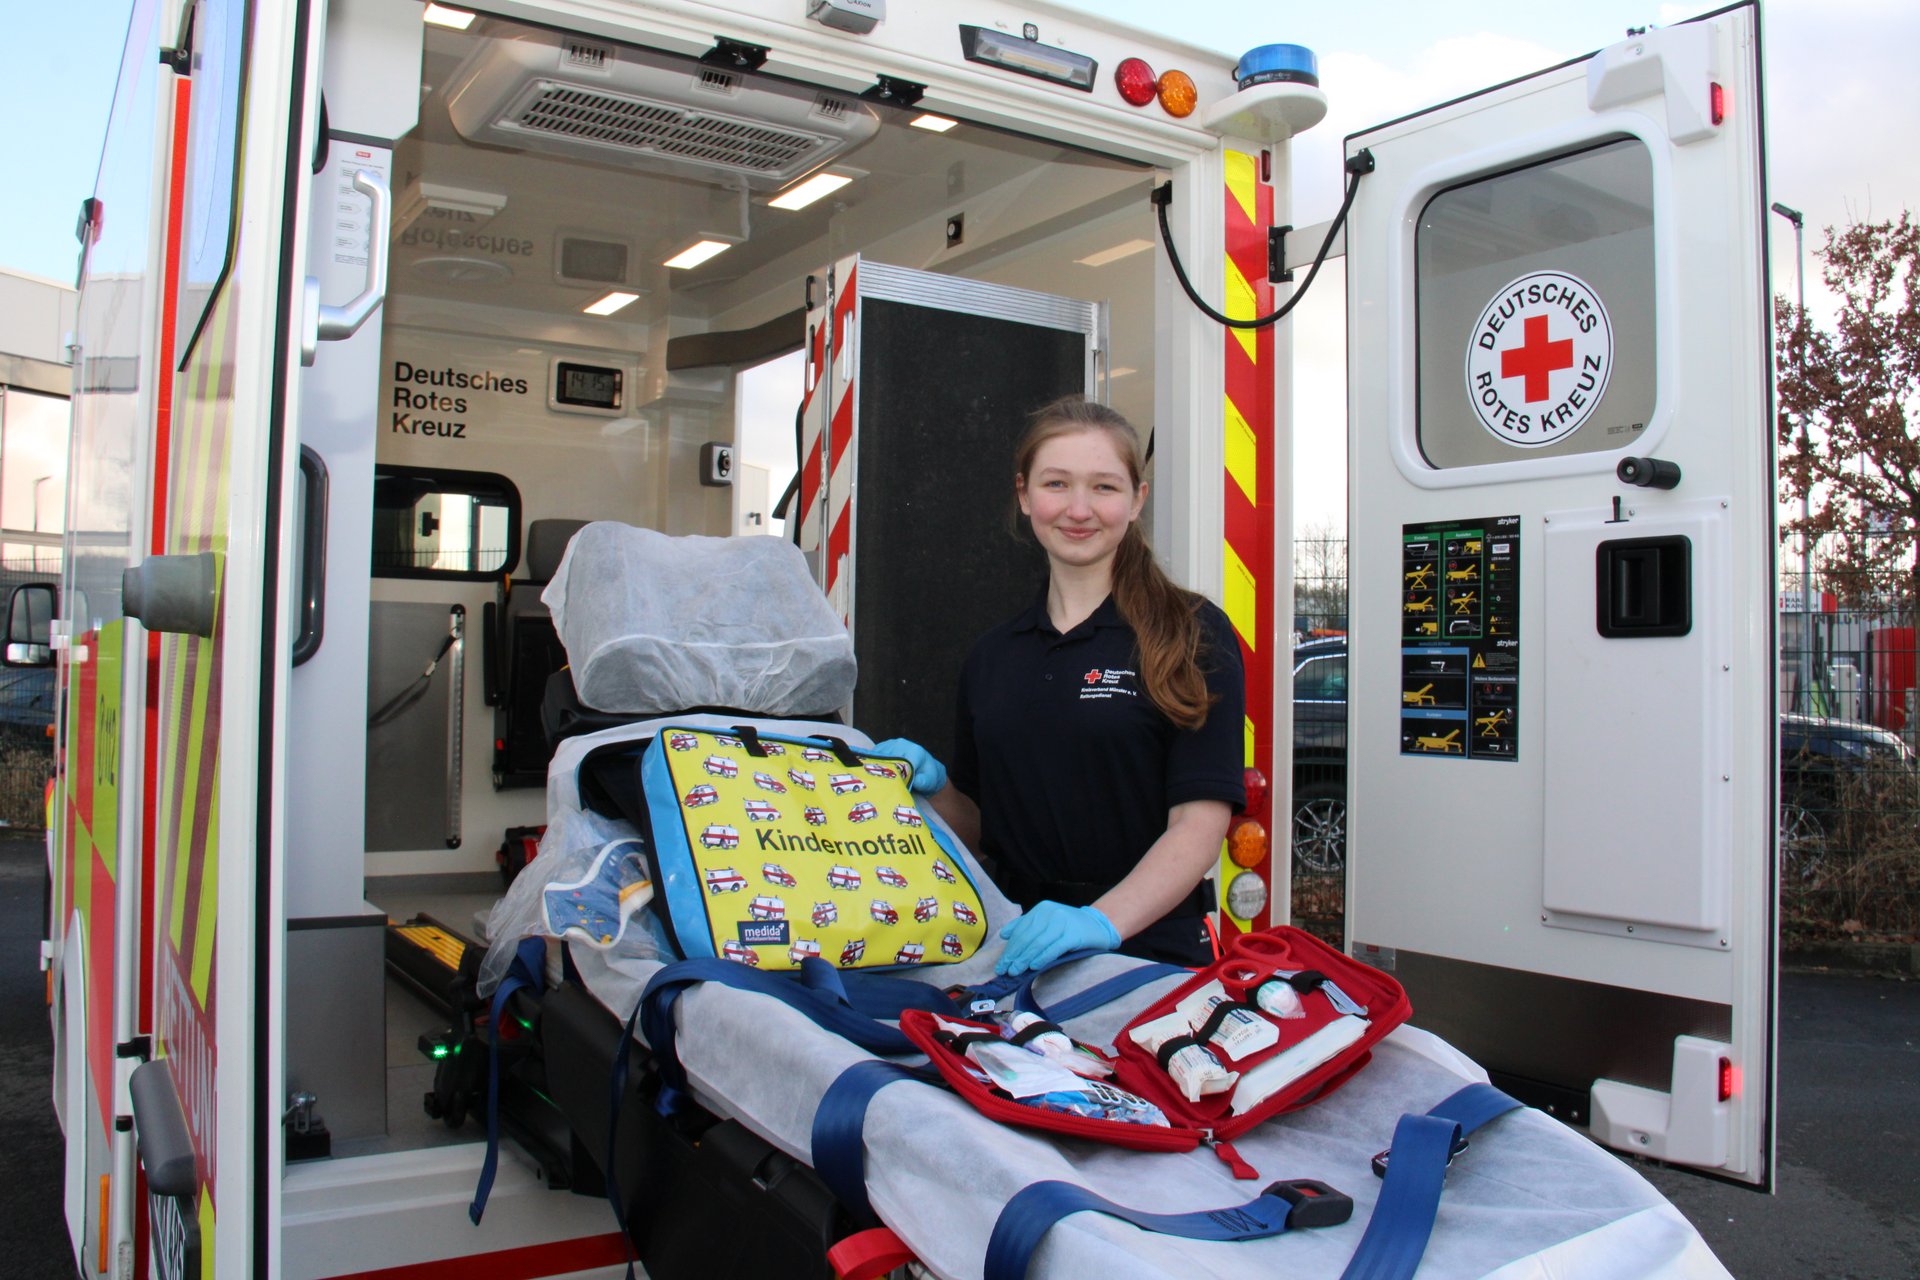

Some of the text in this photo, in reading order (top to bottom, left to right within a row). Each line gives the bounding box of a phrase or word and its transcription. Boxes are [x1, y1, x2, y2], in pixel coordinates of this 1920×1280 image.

[1478, 283, 1597, 351] DEUTSCHES
[394, 361, 528, 394] Deutsches
[393, 387, 468, 413] Rotes
[1476, 354, 1601, 434] ROTES KREUZ
[391, 412, 467, 438] Kreuz
[1497, 517, 1519, 526] stryker
[1496, 639, 1519, 648] stryker
[1104, 669, 1136, 677] Deutsches
[755, 828, 926, 857] Kindernotfall
[744, 925, 781, 937] medida
